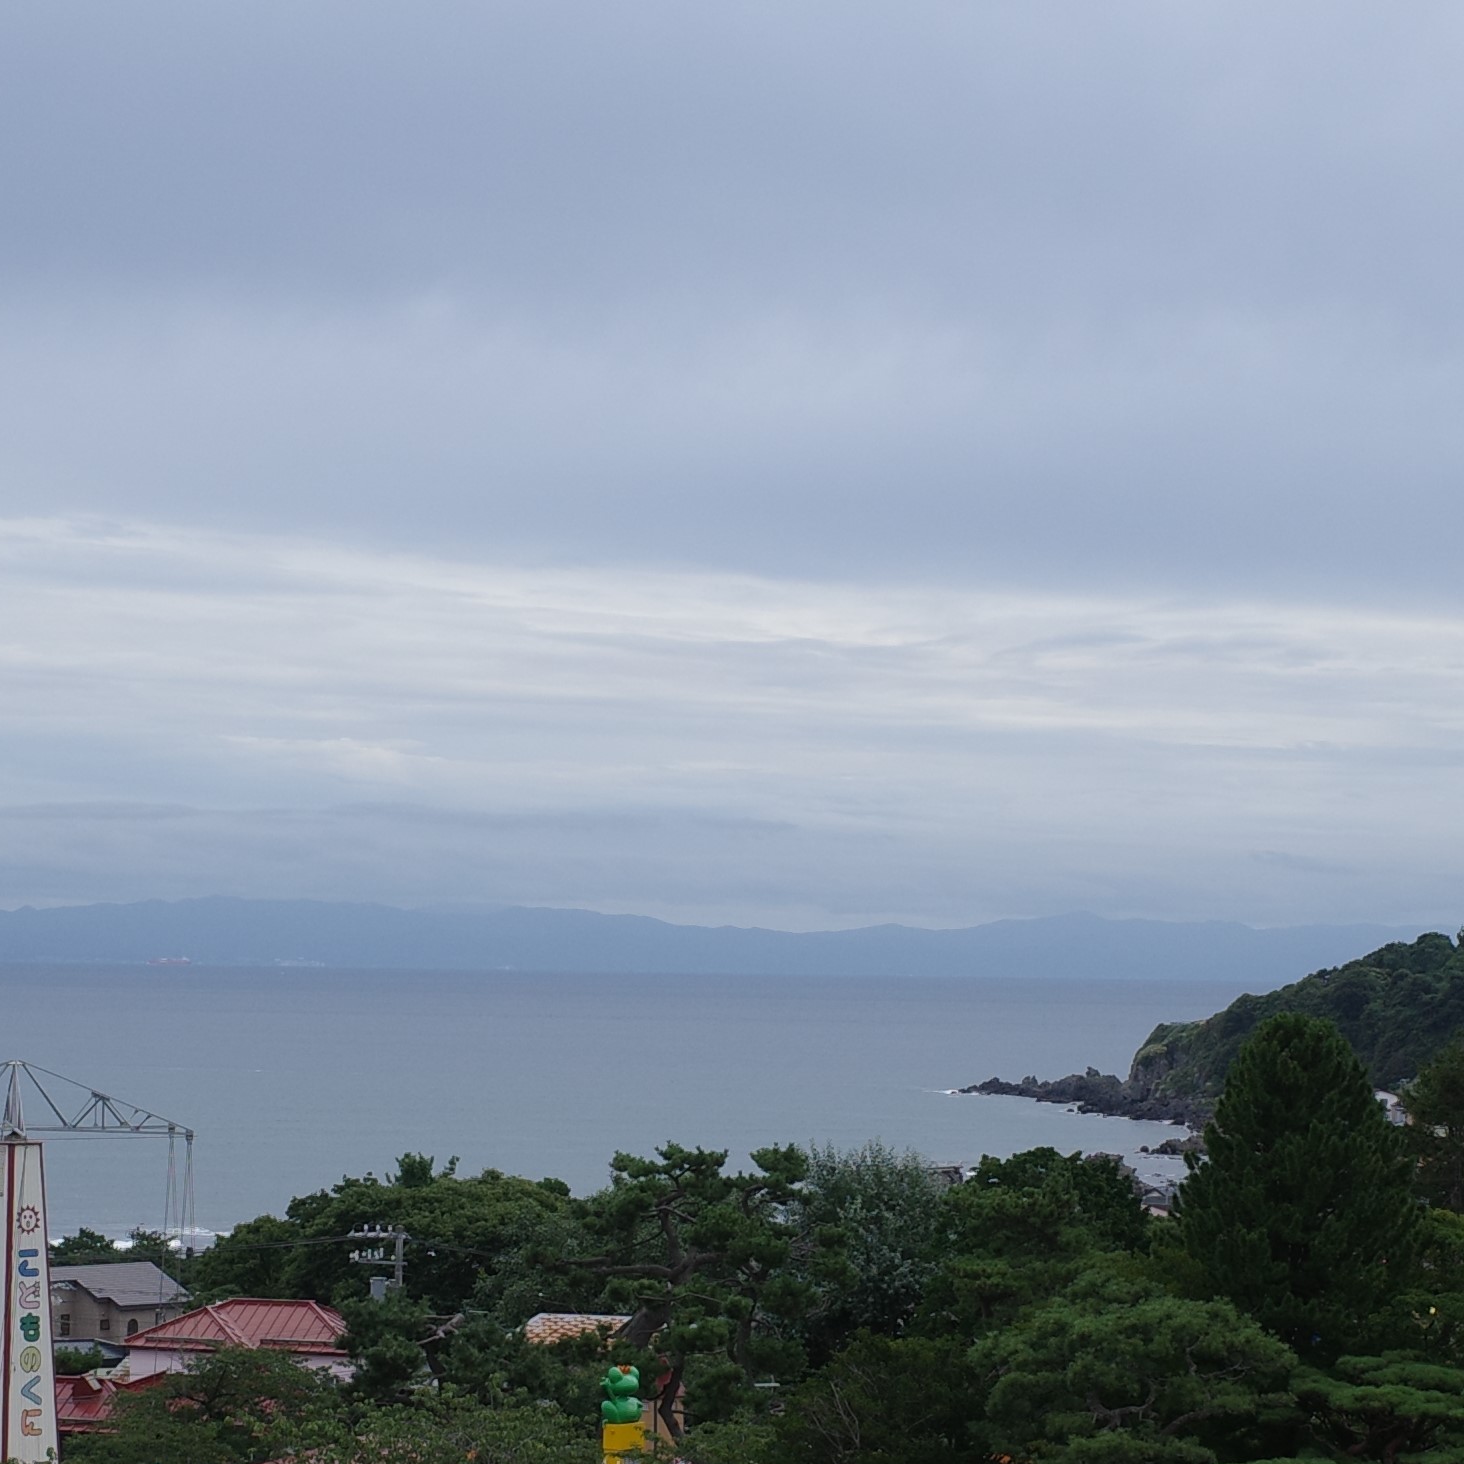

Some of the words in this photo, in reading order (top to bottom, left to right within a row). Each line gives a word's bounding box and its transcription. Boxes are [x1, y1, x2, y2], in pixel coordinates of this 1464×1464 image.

[18, 1248, 43, 1437] こどものくに
